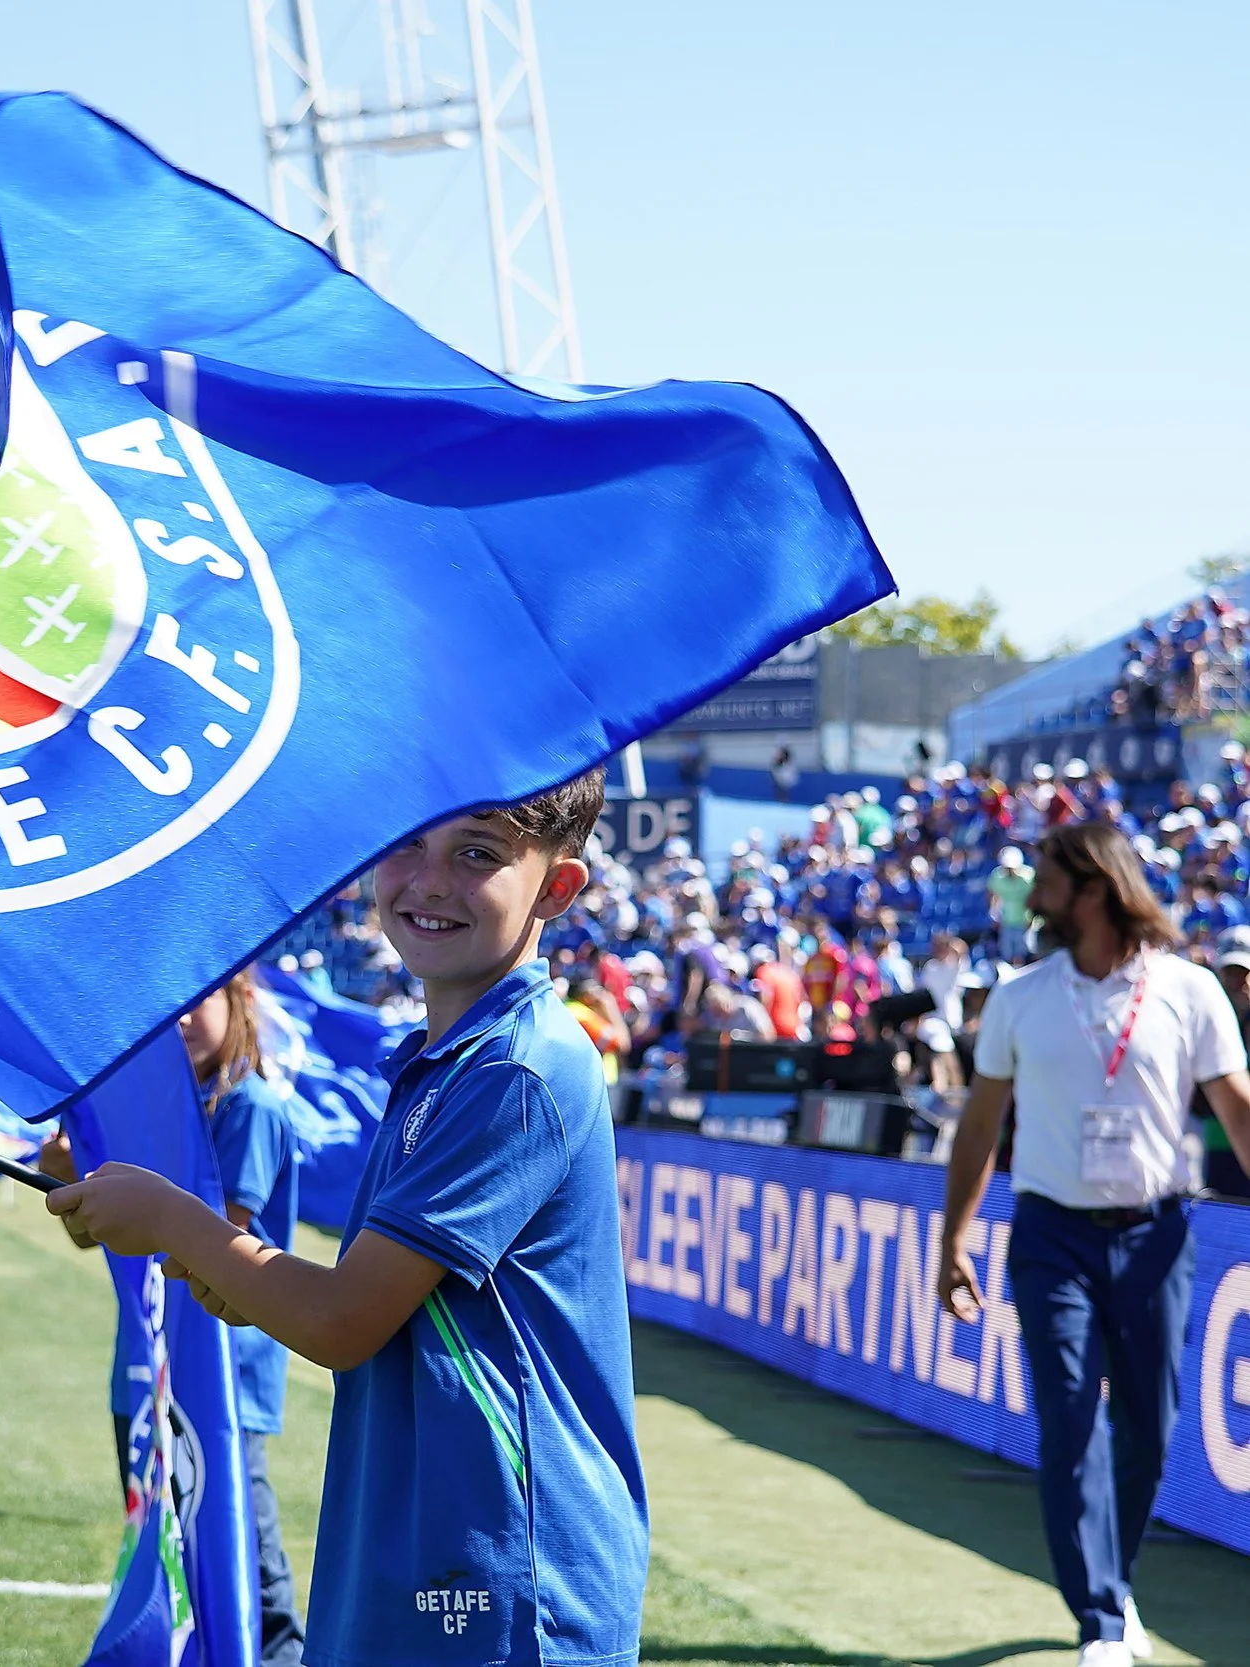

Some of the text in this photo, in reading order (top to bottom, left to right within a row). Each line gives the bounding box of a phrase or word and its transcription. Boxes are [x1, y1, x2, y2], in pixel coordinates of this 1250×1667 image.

[627, 799, 693, 852] DE
[615, 1155, 1028, 1416] SLEEVE PARTNER
[415, 1590, 490, 1612] GETAFE
[443, 1613, 468, 1635] CF
